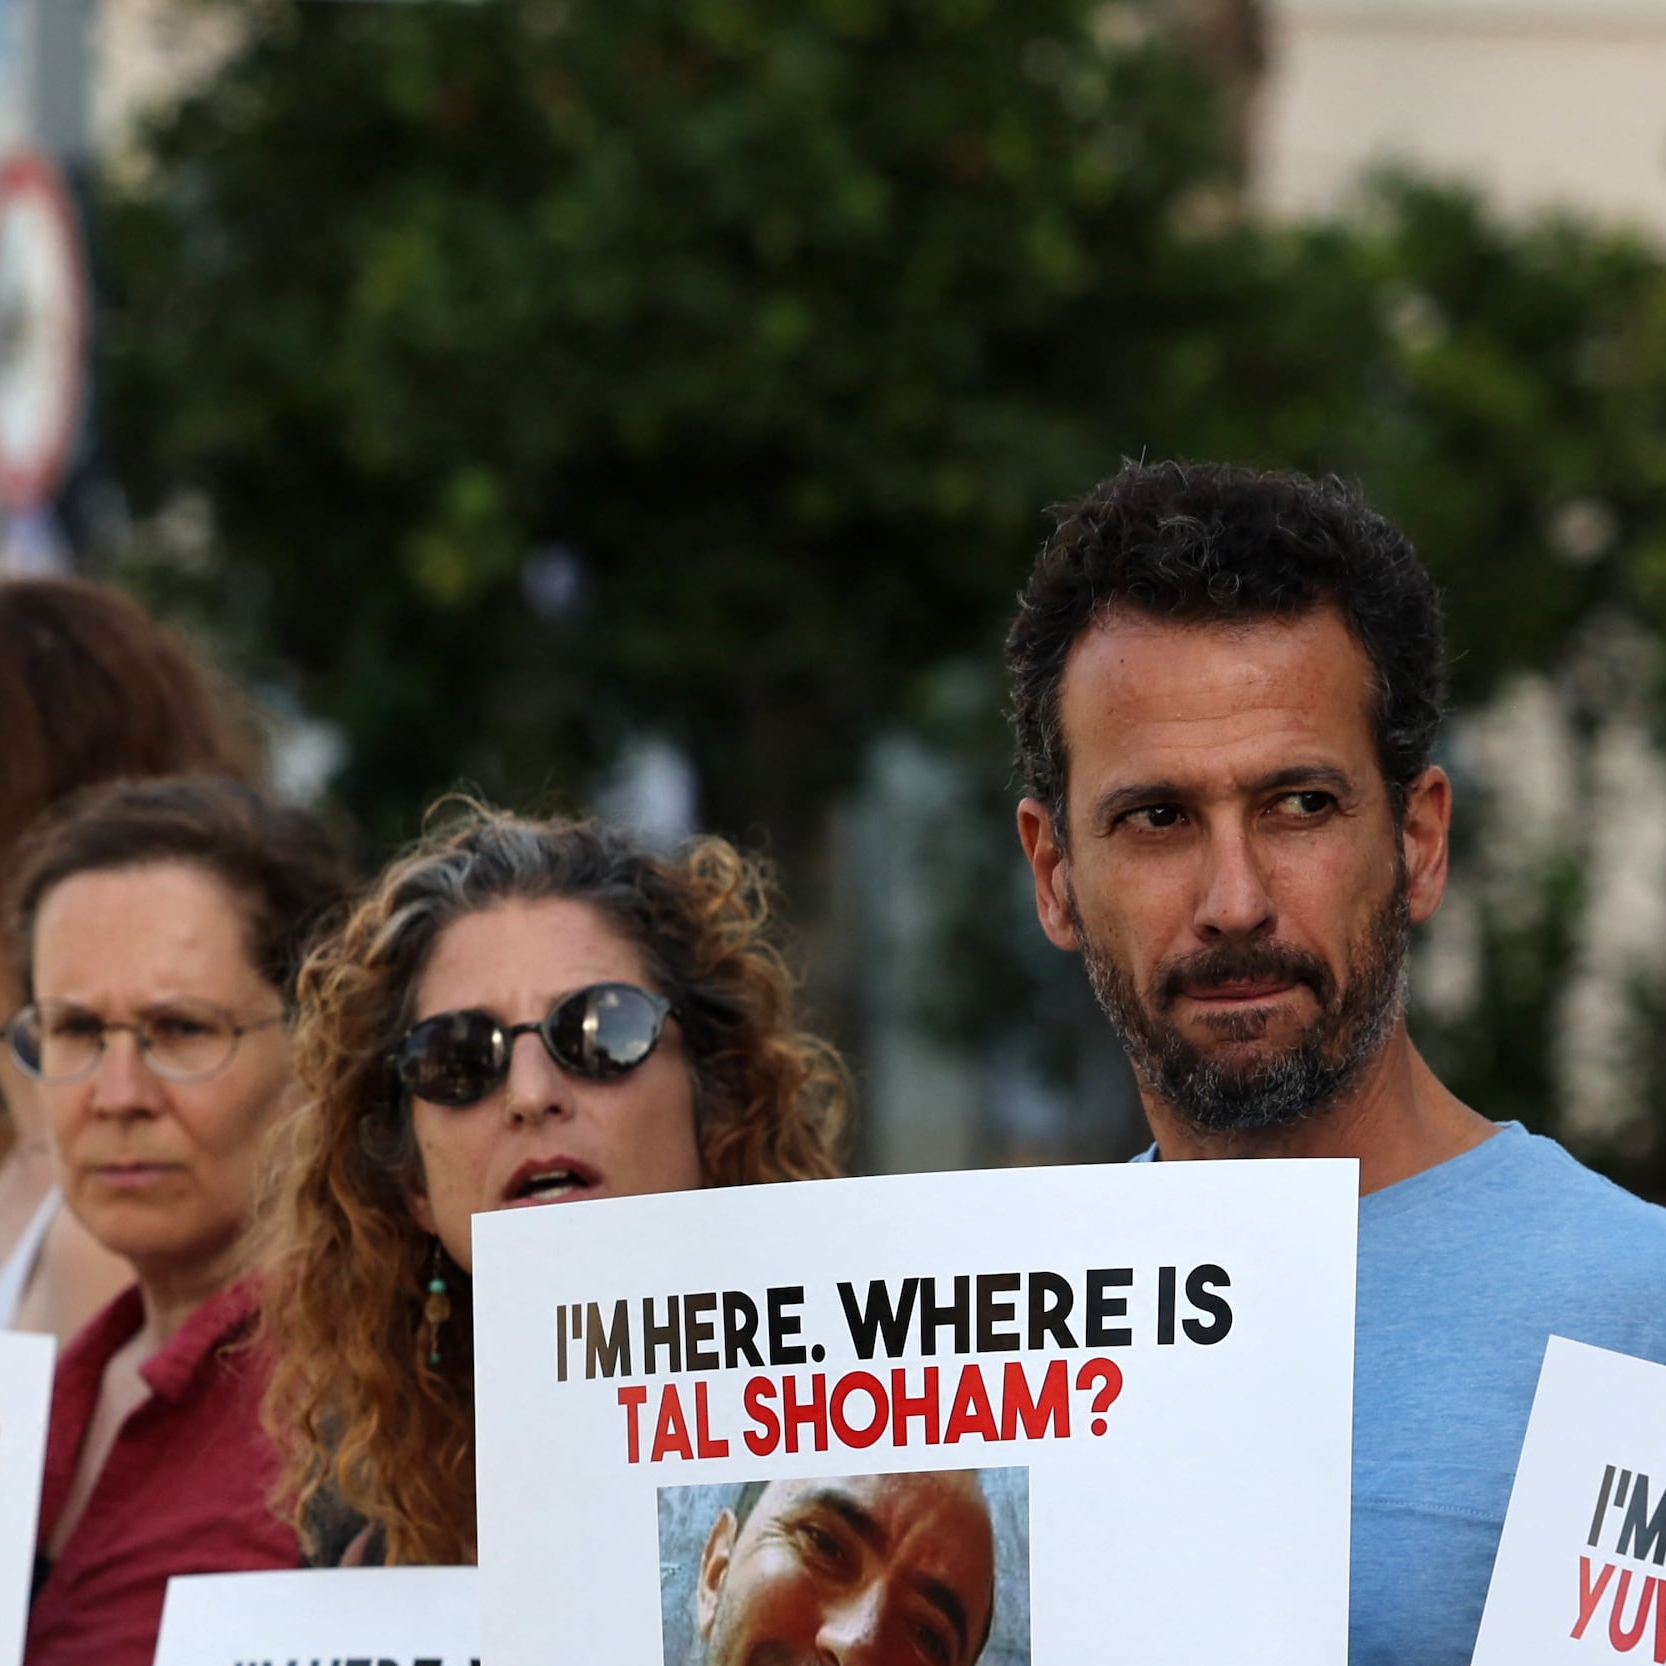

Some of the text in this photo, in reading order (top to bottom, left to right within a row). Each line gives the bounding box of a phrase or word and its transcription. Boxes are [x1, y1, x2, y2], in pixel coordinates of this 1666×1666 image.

[556, 1263, 1233, 1382] I'M HERE. WHERE IS
[617, 1356, 1124, 1464] TAL SHOHAM?
